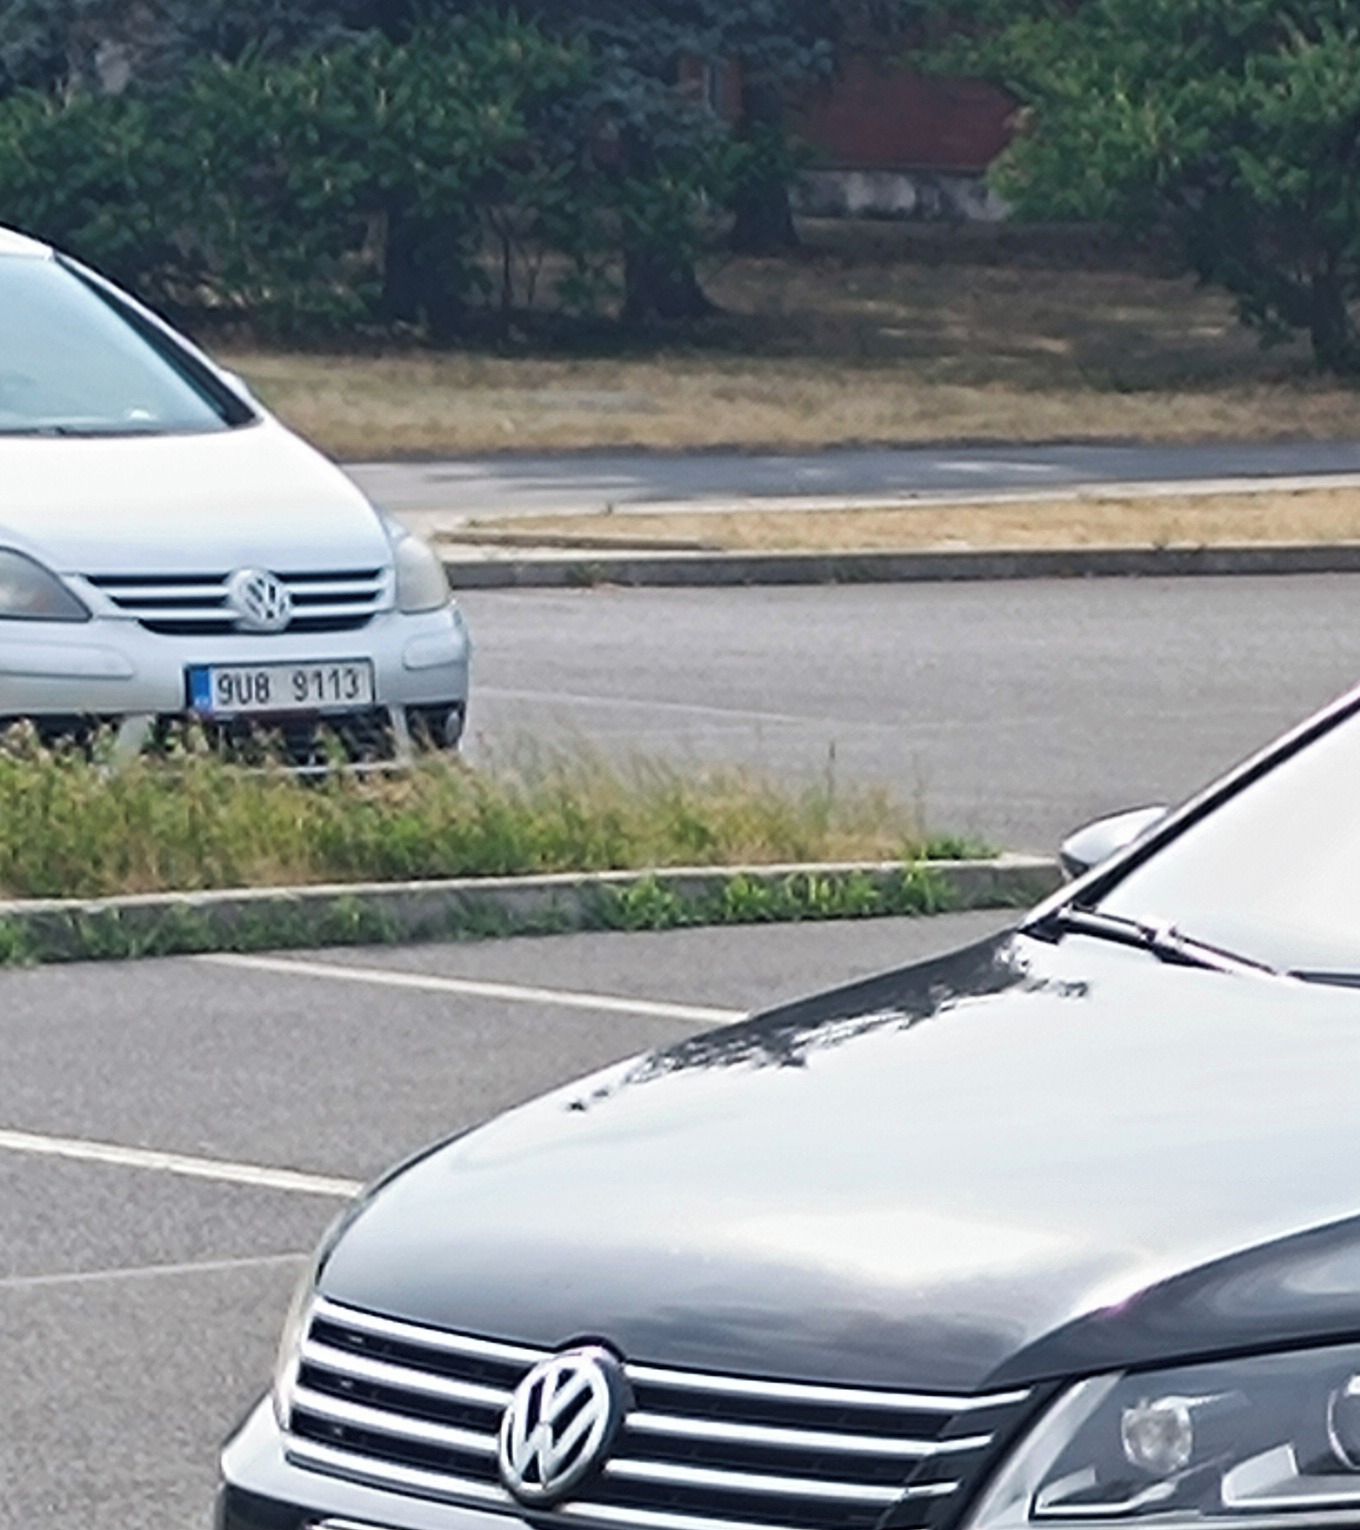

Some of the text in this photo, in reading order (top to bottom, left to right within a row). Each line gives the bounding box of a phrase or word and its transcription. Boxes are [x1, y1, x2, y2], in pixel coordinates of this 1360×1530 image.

[217, 668, 359, 705] 9U8 9113
[500, 1345, 611, 1496] VW
